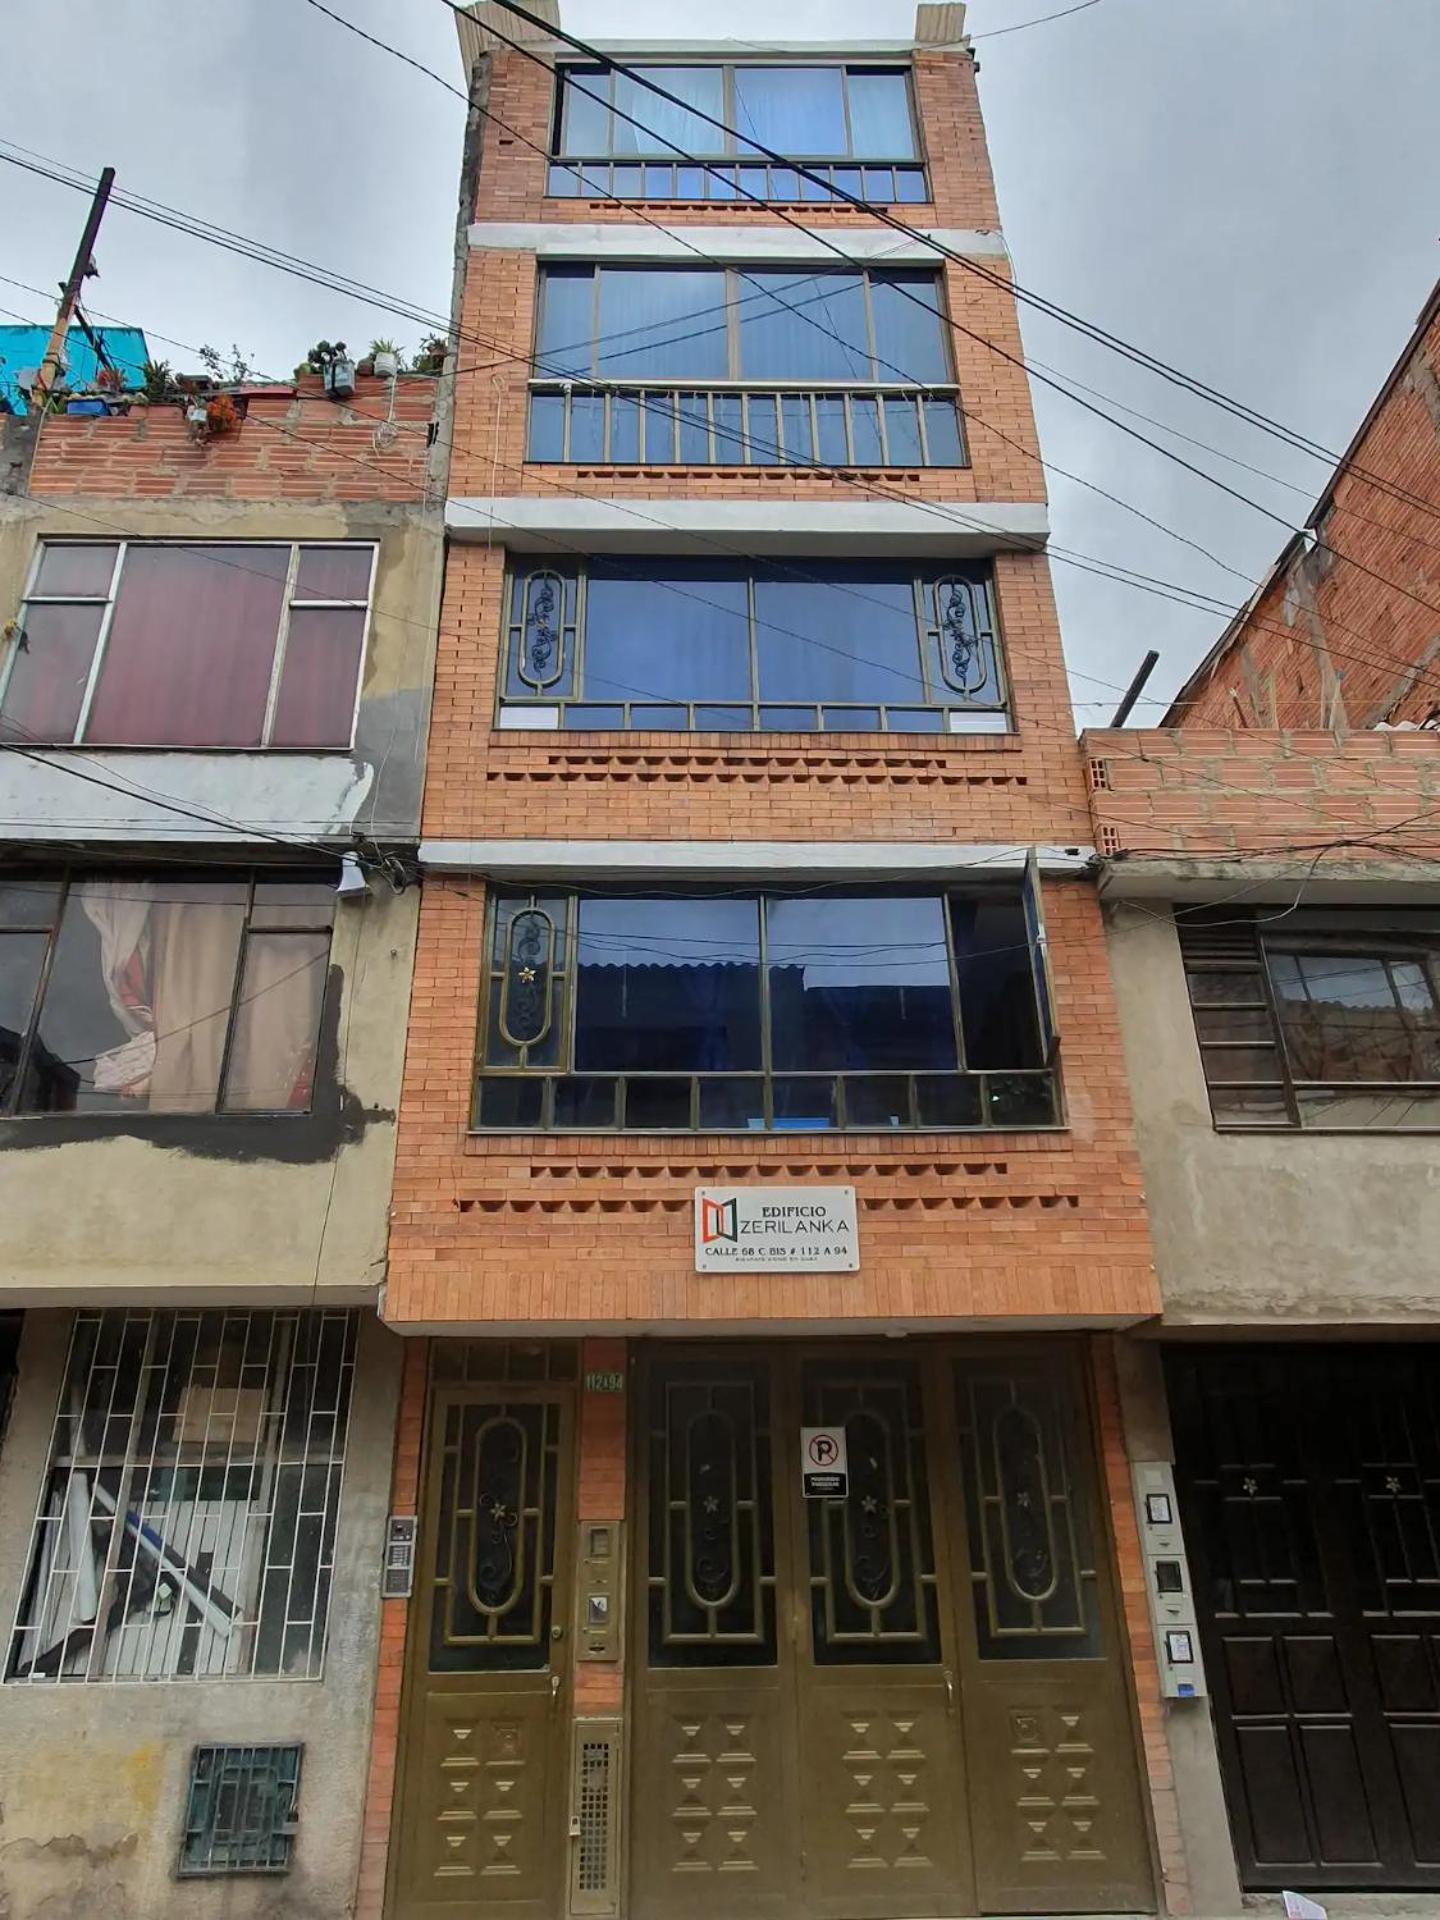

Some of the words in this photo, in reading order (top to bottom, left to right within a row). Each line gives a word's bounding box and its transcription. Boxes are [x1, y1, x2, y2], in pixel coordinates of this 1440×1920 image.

[761, 1206, 827, 1218] EDIFICIO
[740, 1219, 850, 1234] ZERILANKA
[705, 1247, 738, 1256] CALLE
[741, 1247, 755, 1256] 68
[758, 1247, 766, 1256] C
[801, 1246, 820, 1255] 112
[824, 1246, 831, 1255] A
[834, 1246, 848, 1255] 94
